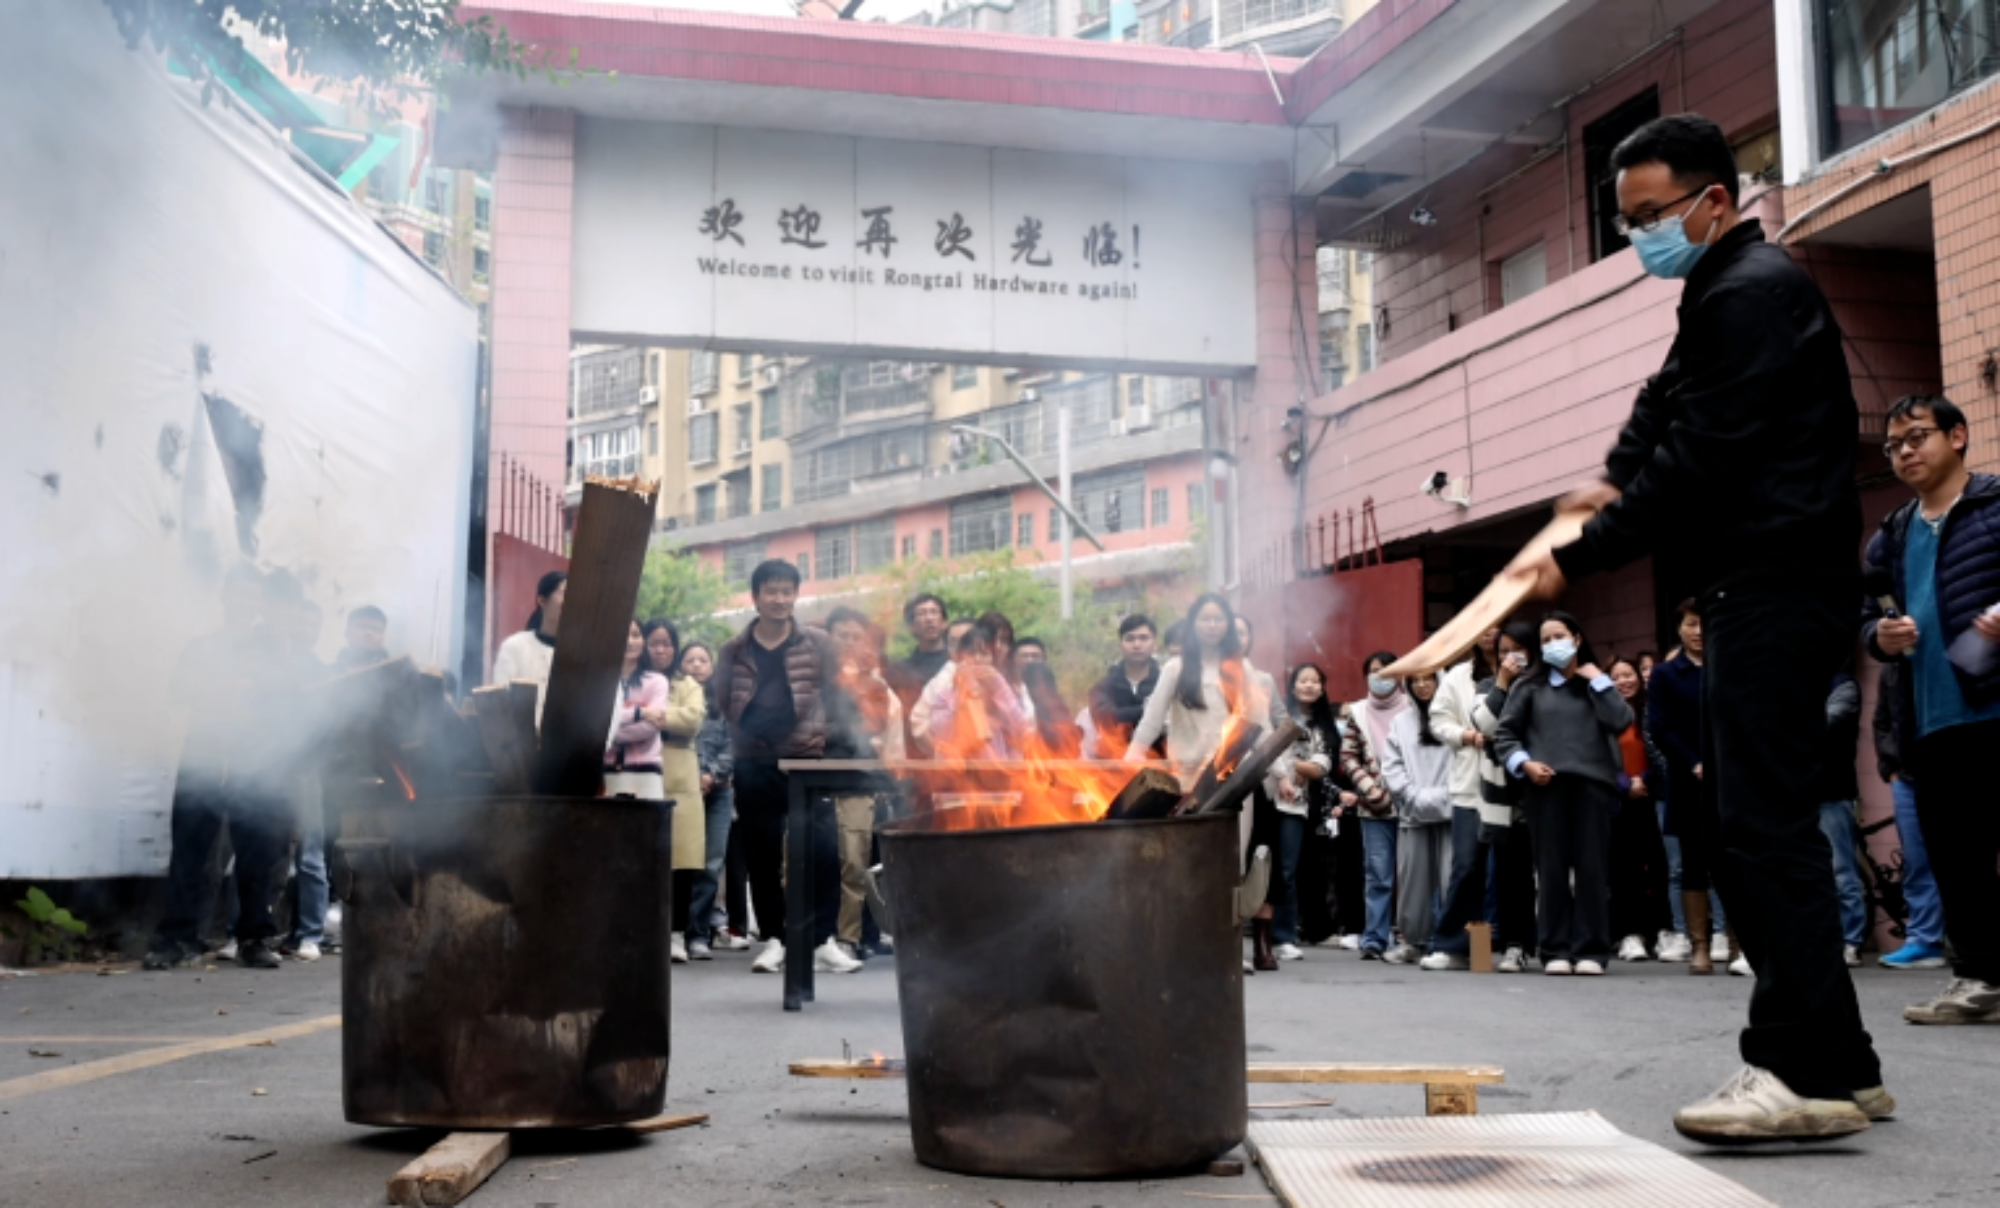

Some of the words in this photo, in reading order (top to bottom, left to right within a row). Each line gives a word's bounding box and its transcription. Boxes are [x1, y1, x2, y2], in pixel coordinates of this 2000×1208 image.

[697, 257, 791, 279] Welcome
[802, 265, 824, 281] to
[829, 267, 874, 284] visit
[884, 269, 962, 292] Rongtai
[974, 274, 1069, 296] Hardware
[1079, 280, 1138, 300] again!
